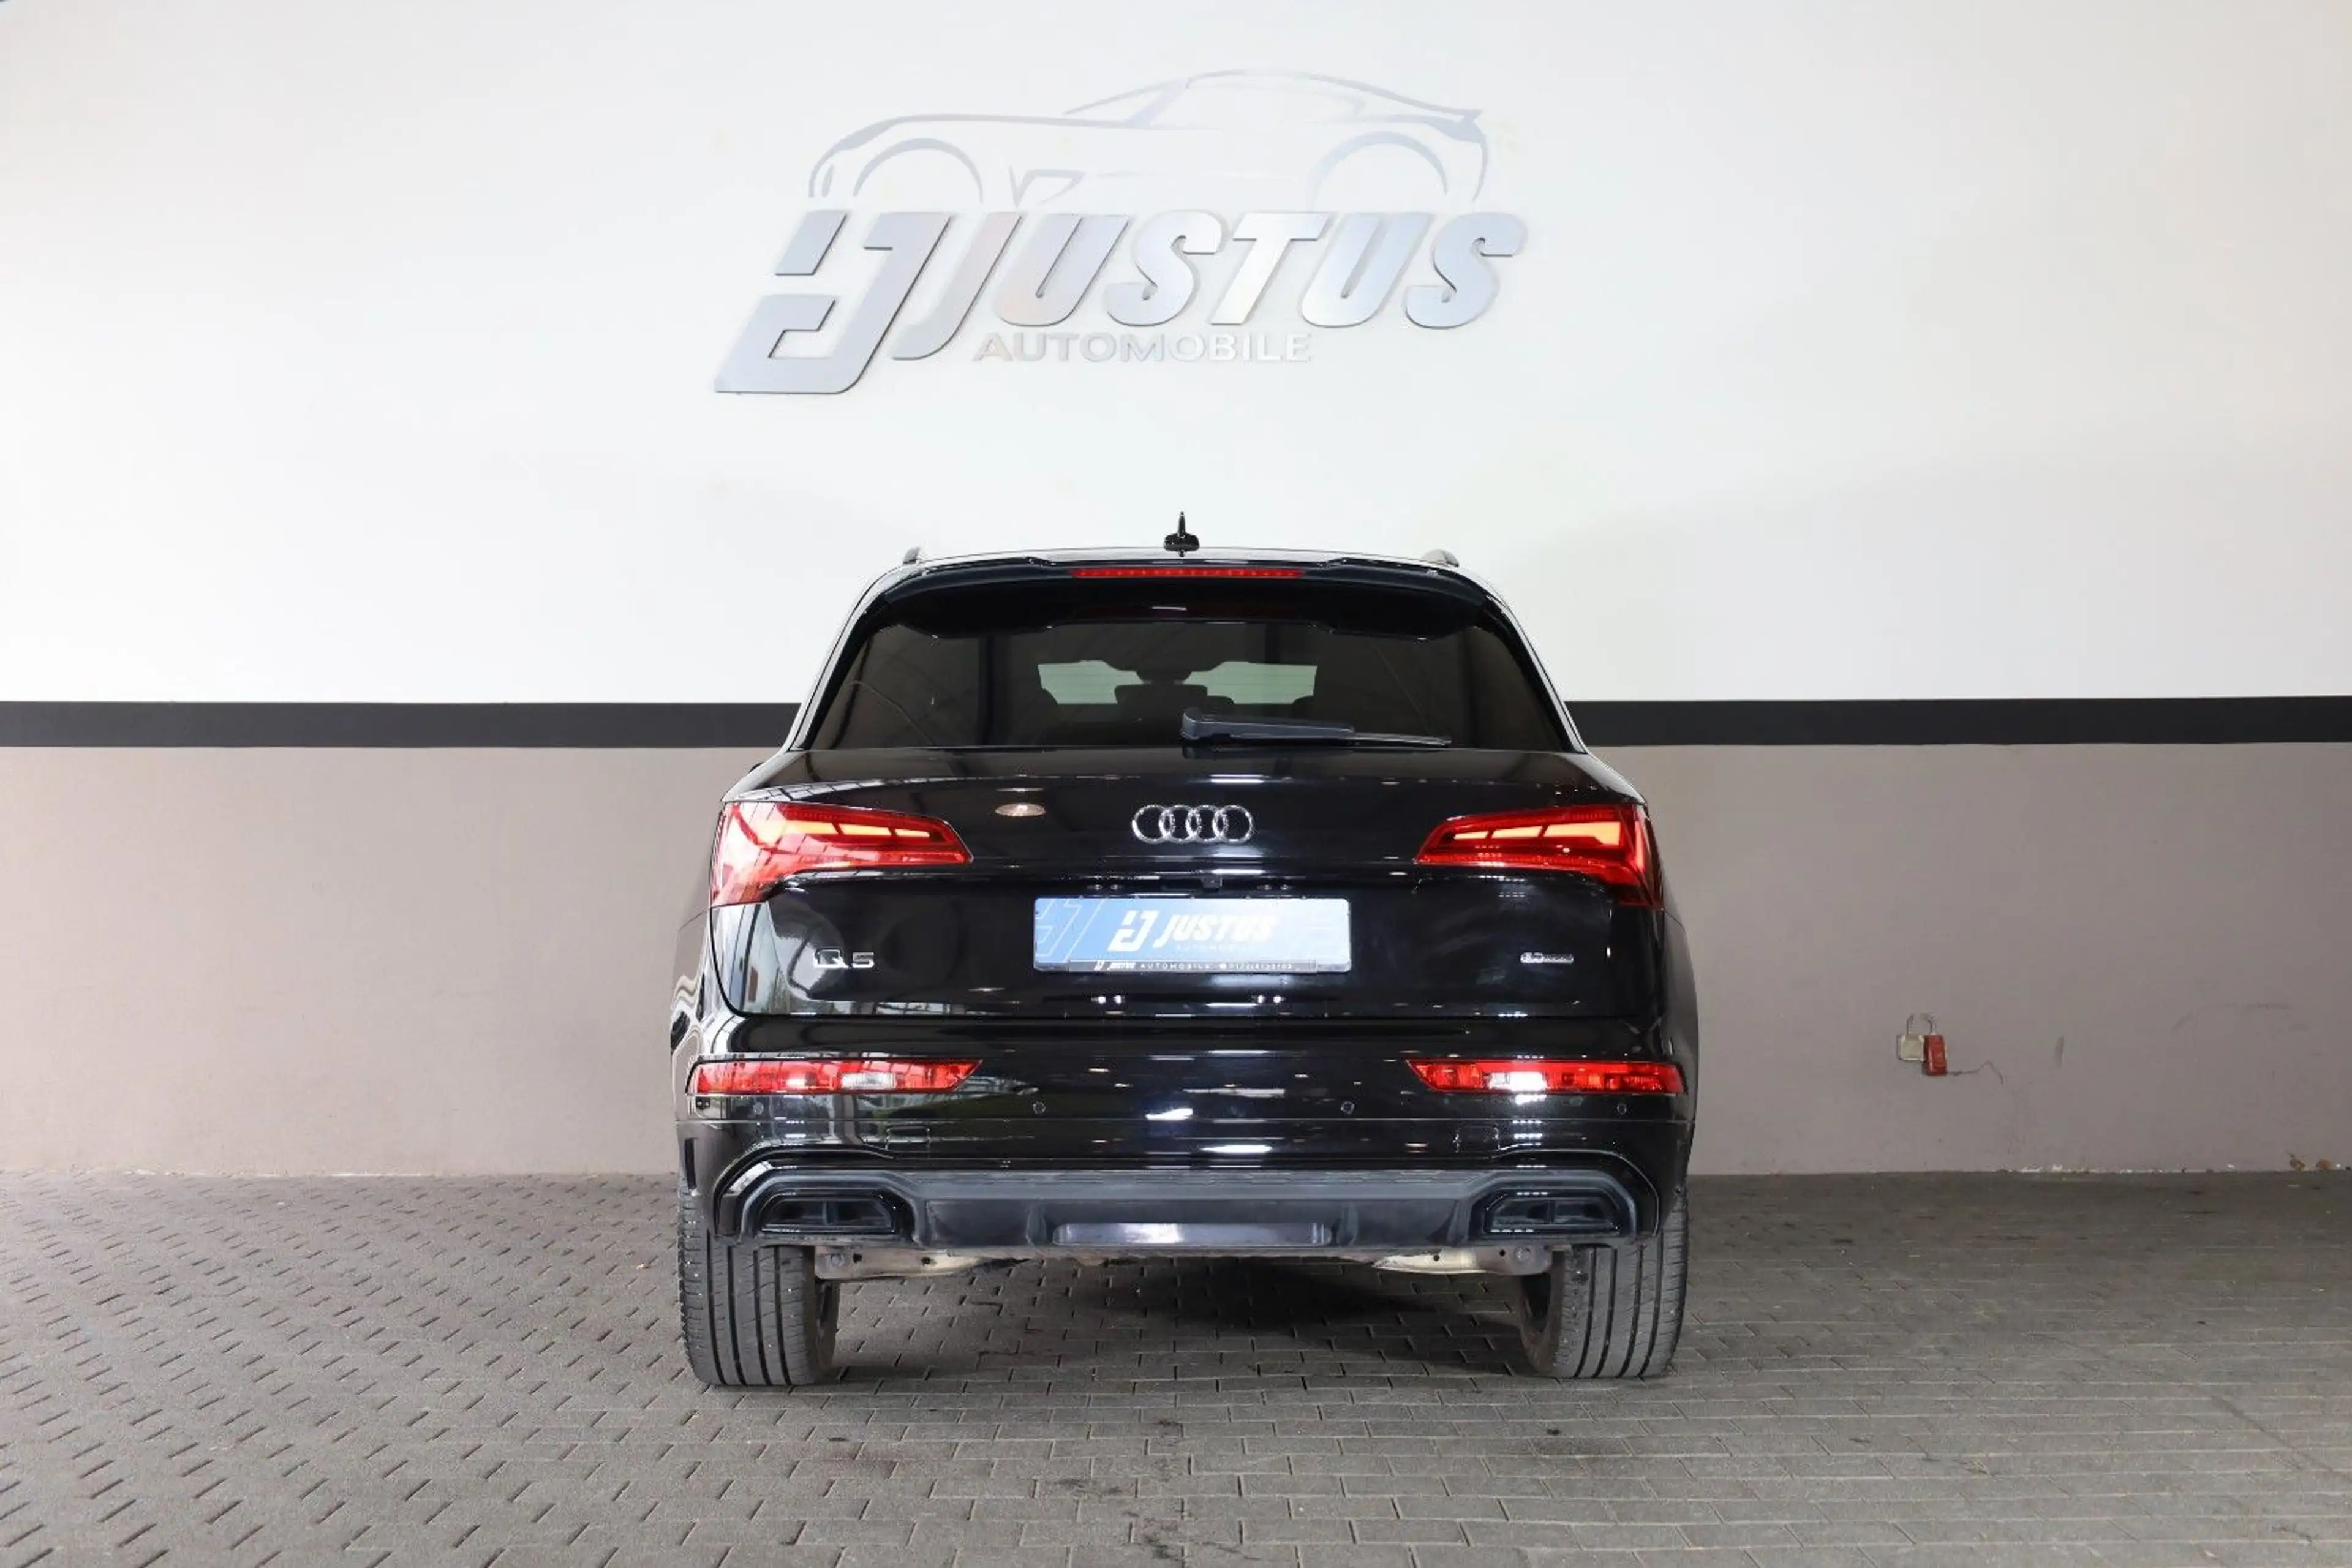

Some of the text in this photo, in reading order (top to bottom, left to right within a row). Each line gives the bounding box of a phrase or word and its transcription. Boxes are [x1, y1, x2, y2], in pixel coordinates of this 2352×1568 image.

[891, 210, 1526, 360] JUSTUS
[976, 331, 1311, 363] AUTOMOBILE
[1153, 914, 1278, 948] JUSTUS
[813, 949, 874, 968] Q5
